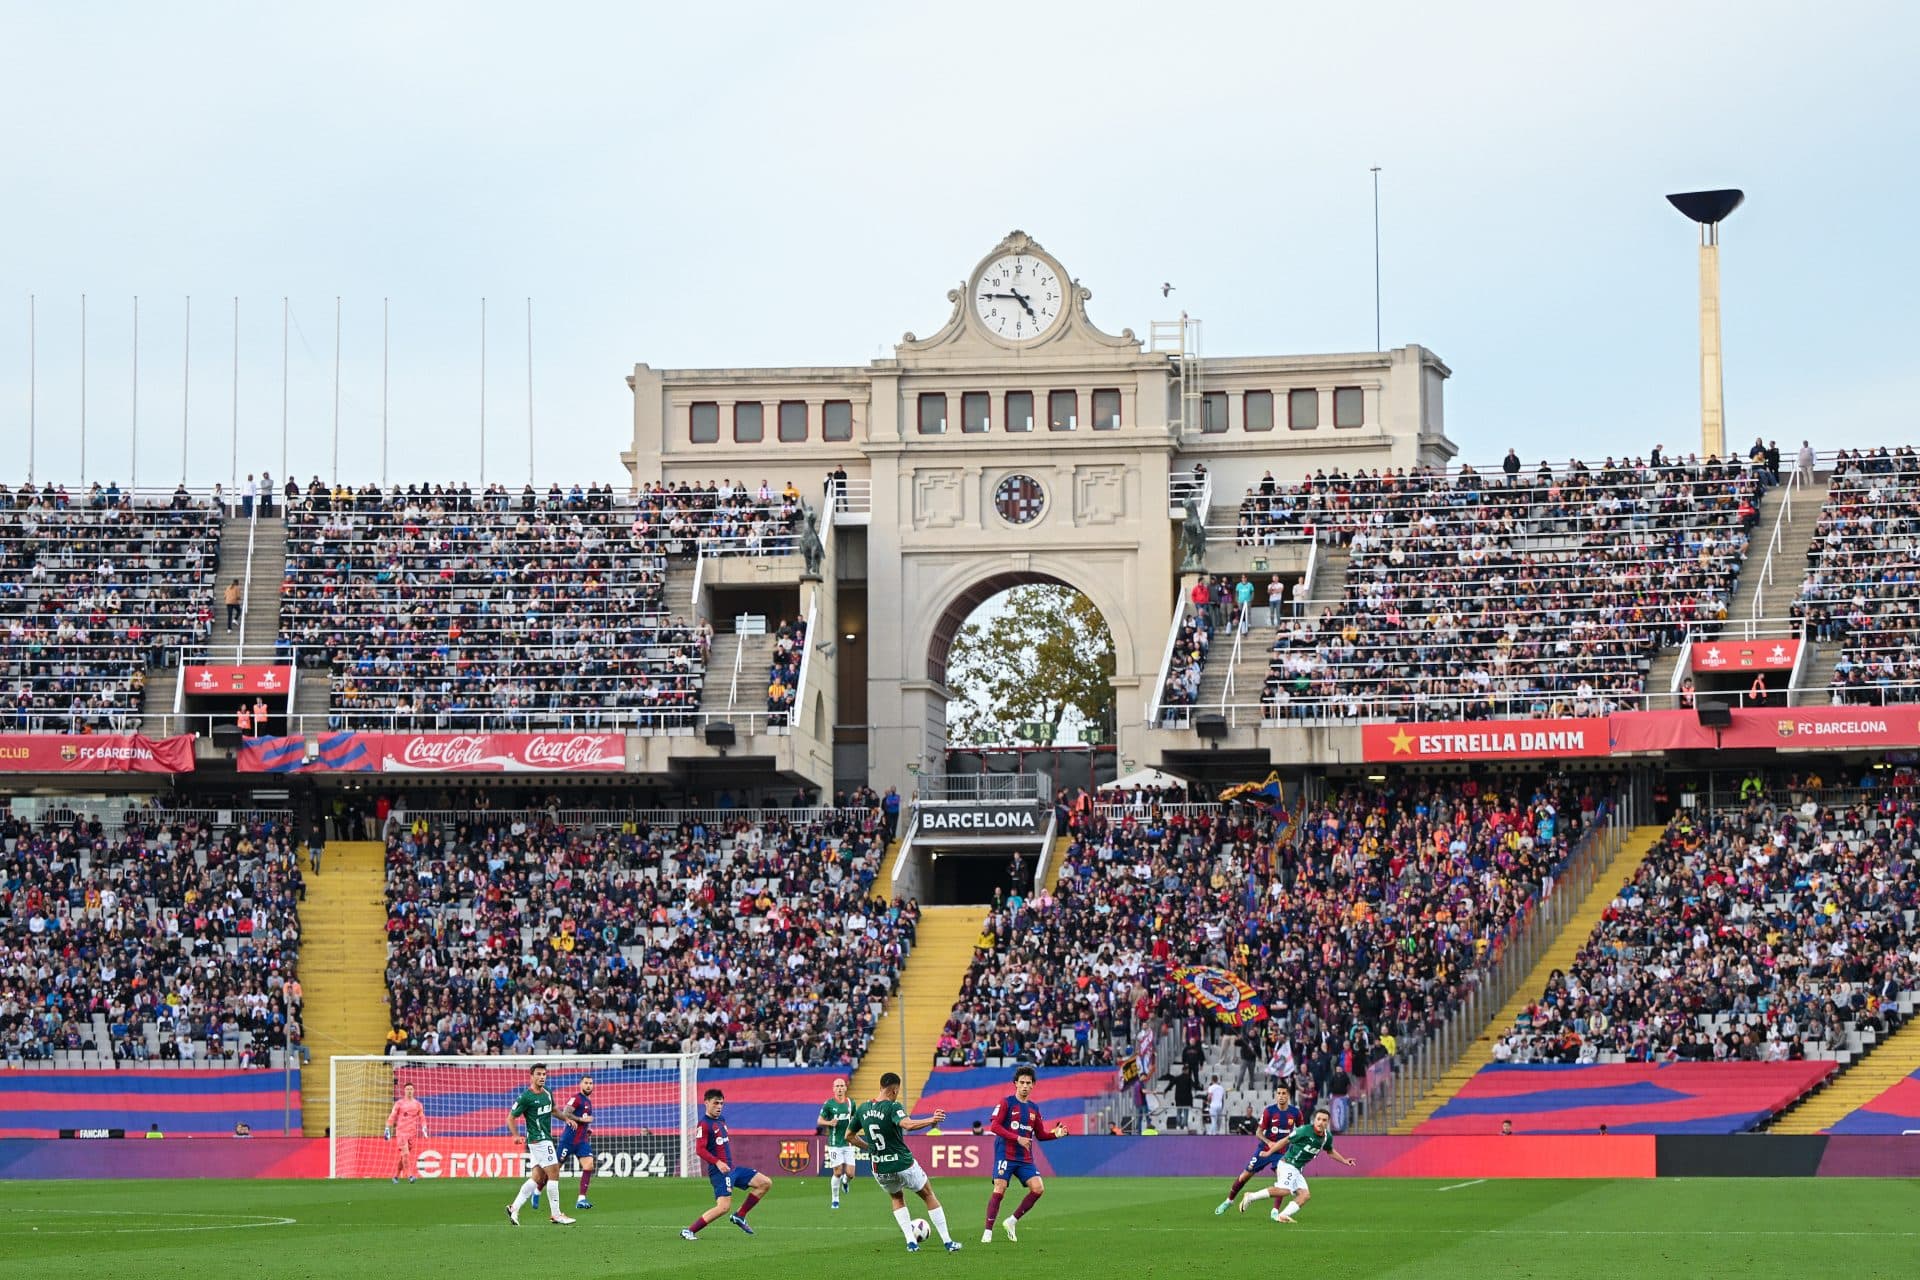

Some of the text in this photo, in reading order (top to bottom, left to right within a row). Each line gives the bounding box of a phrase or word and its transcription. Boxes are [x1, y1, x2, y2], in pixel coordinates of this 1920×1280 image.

[1015, 265, 1022, 273] 12
[1032, 269, 1036, 277] 1
[992, 278, 1000, 287] 10
[1041, 277, 1046, 286] 2
[1046, 292, 1052, 301] 3
[991, 308, 997, 317] 8
[1041, 307, 1046, 315] 4
[1001, 317, 1006, 325] 7
[1032, 316, 1037, 325] 5
[1016, 321, 1022, 330] 6
[1798, 721, 1887, 734] FC BARCELONA
[1419, 731, 1584, 753] ESTRELLA DAMM
[80, 748, 96, 759] FC
[404, 736, 486, 763] Coca-Cola
[525, 736, 606, 763] Coca-Cola
[922, 812, 1035, 829] BARCELONA
[868, 1124, 886, 1151] 5
[547, 1145, 554, 1154] 6
[561, 1148, 569, 1157] 5
[871, 1153, 899, 1163] DIGI
[931, 1145, 980, 1168] FES
[1249, 1156, 1258, 1166] 2
[597, 1152, 667, 1178] 2024
[997, 1160, 1008, 1170] 14
[1287, 1173, 1293, 1181] 2
[725, 1177, 731, 1187] 8
